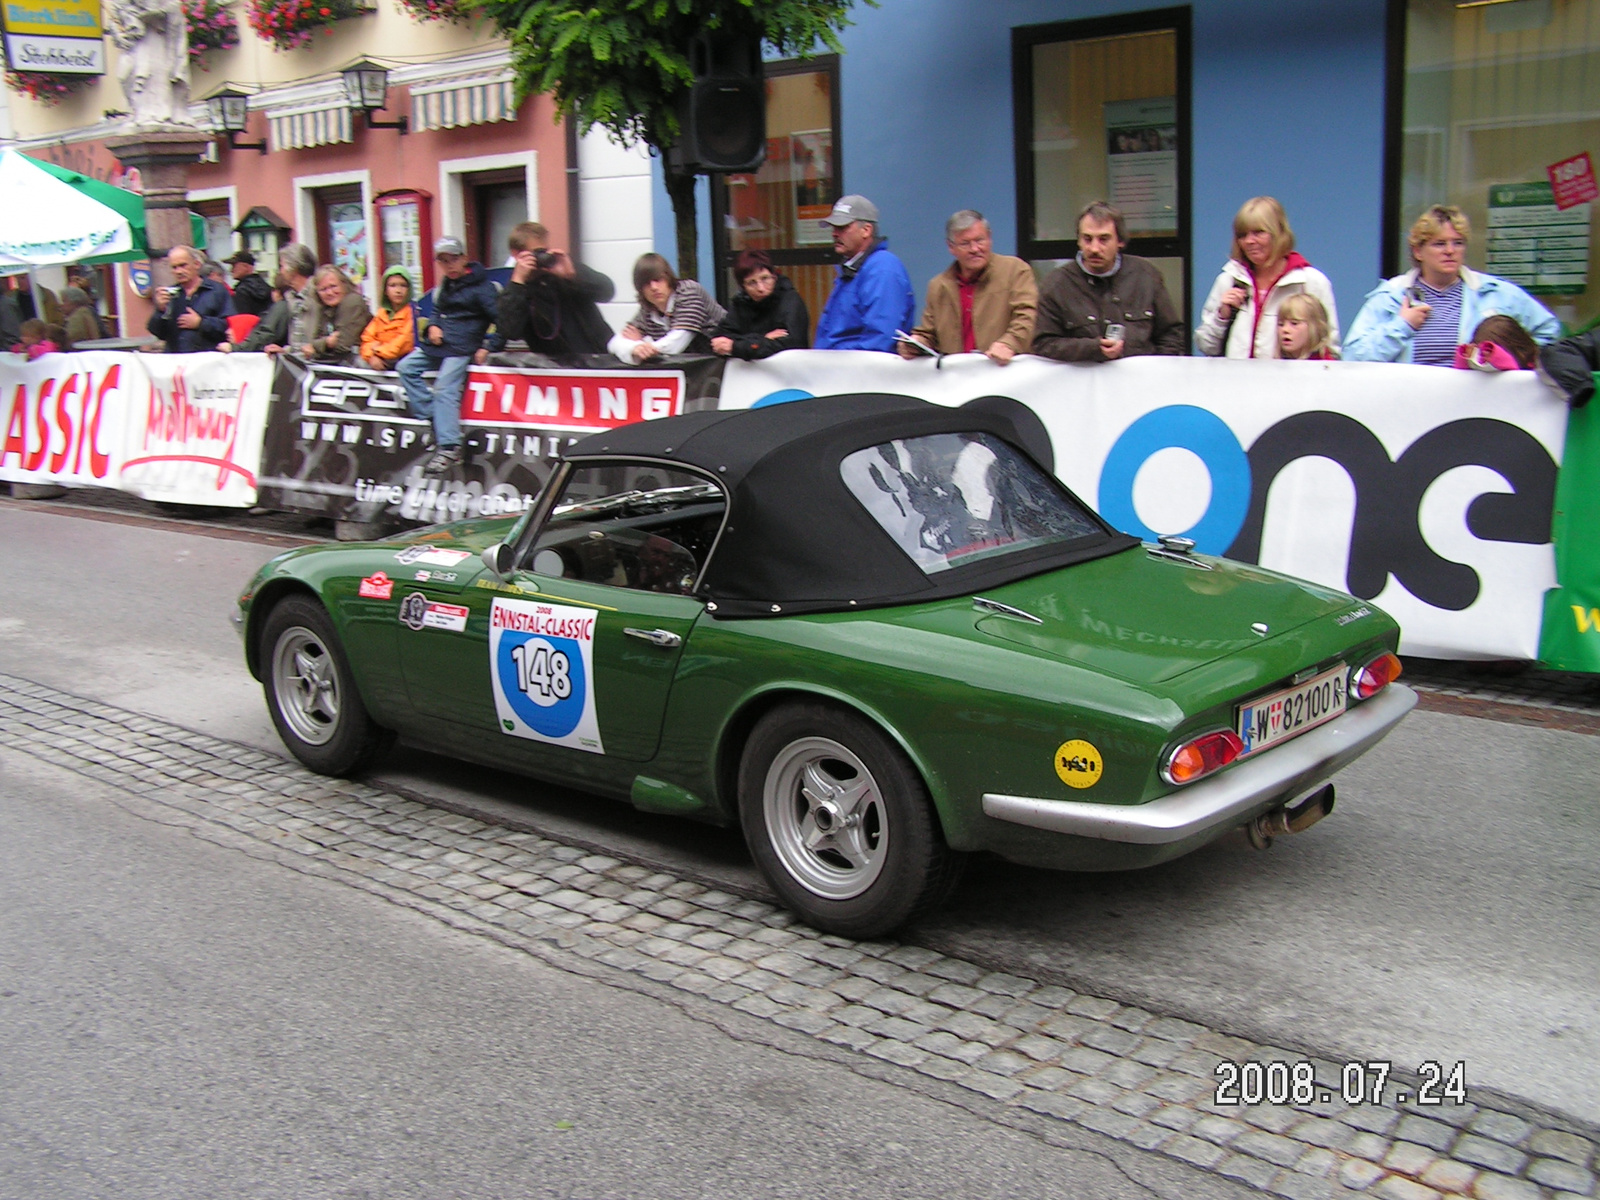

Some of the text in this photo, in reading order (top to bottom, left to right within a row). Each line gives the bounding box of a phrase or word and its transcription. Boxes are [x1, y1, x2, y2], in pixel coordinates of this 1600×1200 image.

[310, 379, 672, 421] SPO TIMING
[355, 477, 402, 505] time
[493, 606, 593, 641] ENNSTAL-CLASSIC
[511, 644, 573, 700] 148
[1257, 706, 1270, 742] W
[1283, 681, 1330, 731] 82100
[1333, 676, 1345, 709] R
